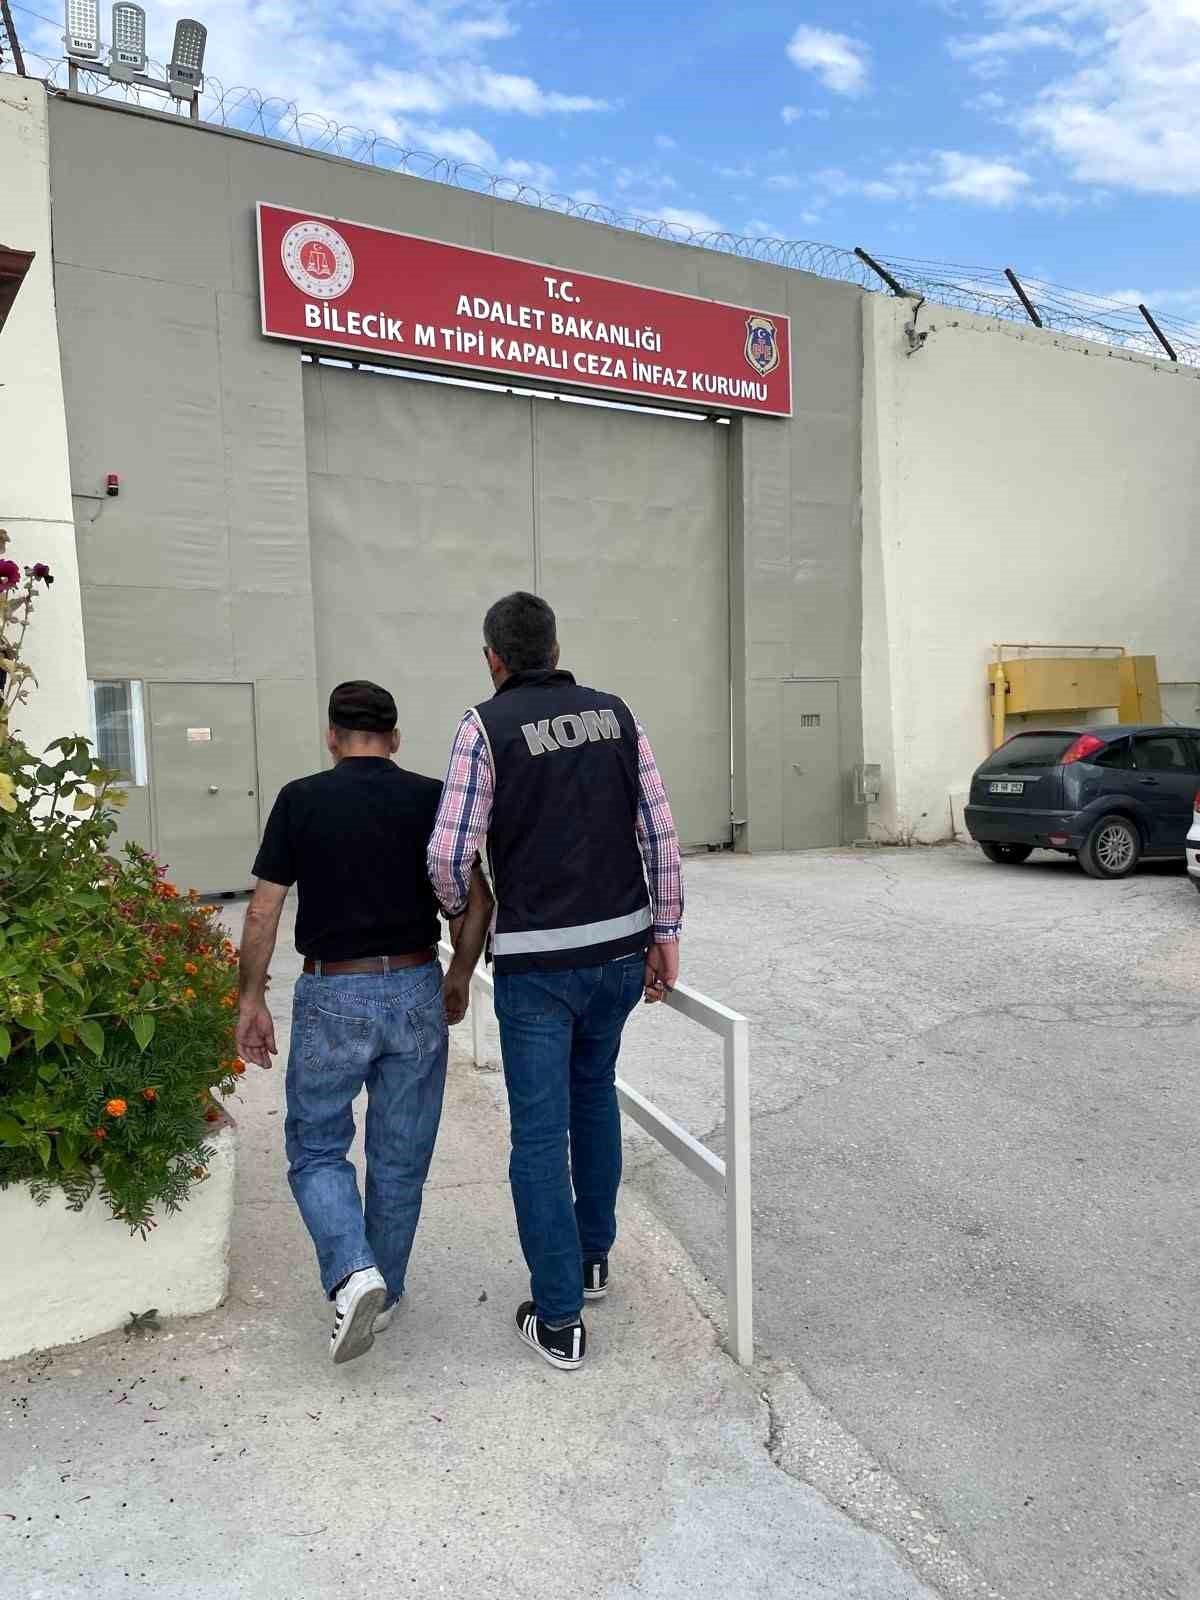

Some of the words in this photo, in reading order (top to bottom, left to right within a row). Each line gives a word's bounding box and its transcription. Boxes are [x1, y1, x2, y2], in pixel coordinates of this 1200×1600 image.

[544, 277, 581, 303] T.C.
[456, 295, 545, 331] ADALET
[551, 313, 661, 353] BAKANLIĞI
[304, 302, 404, 342] BİLECİK
[414, 324, 436, 348] M
[441, 326, 484, 356] TİPİ
[490, 337, 568, 370] KAPALI
[573, 352, 627, 379] CEZA
[632, 357, 688, 389] İNFAZ
[692, 373, 768, 401] KURUMU
[520, 710, 621, 756] KOM
